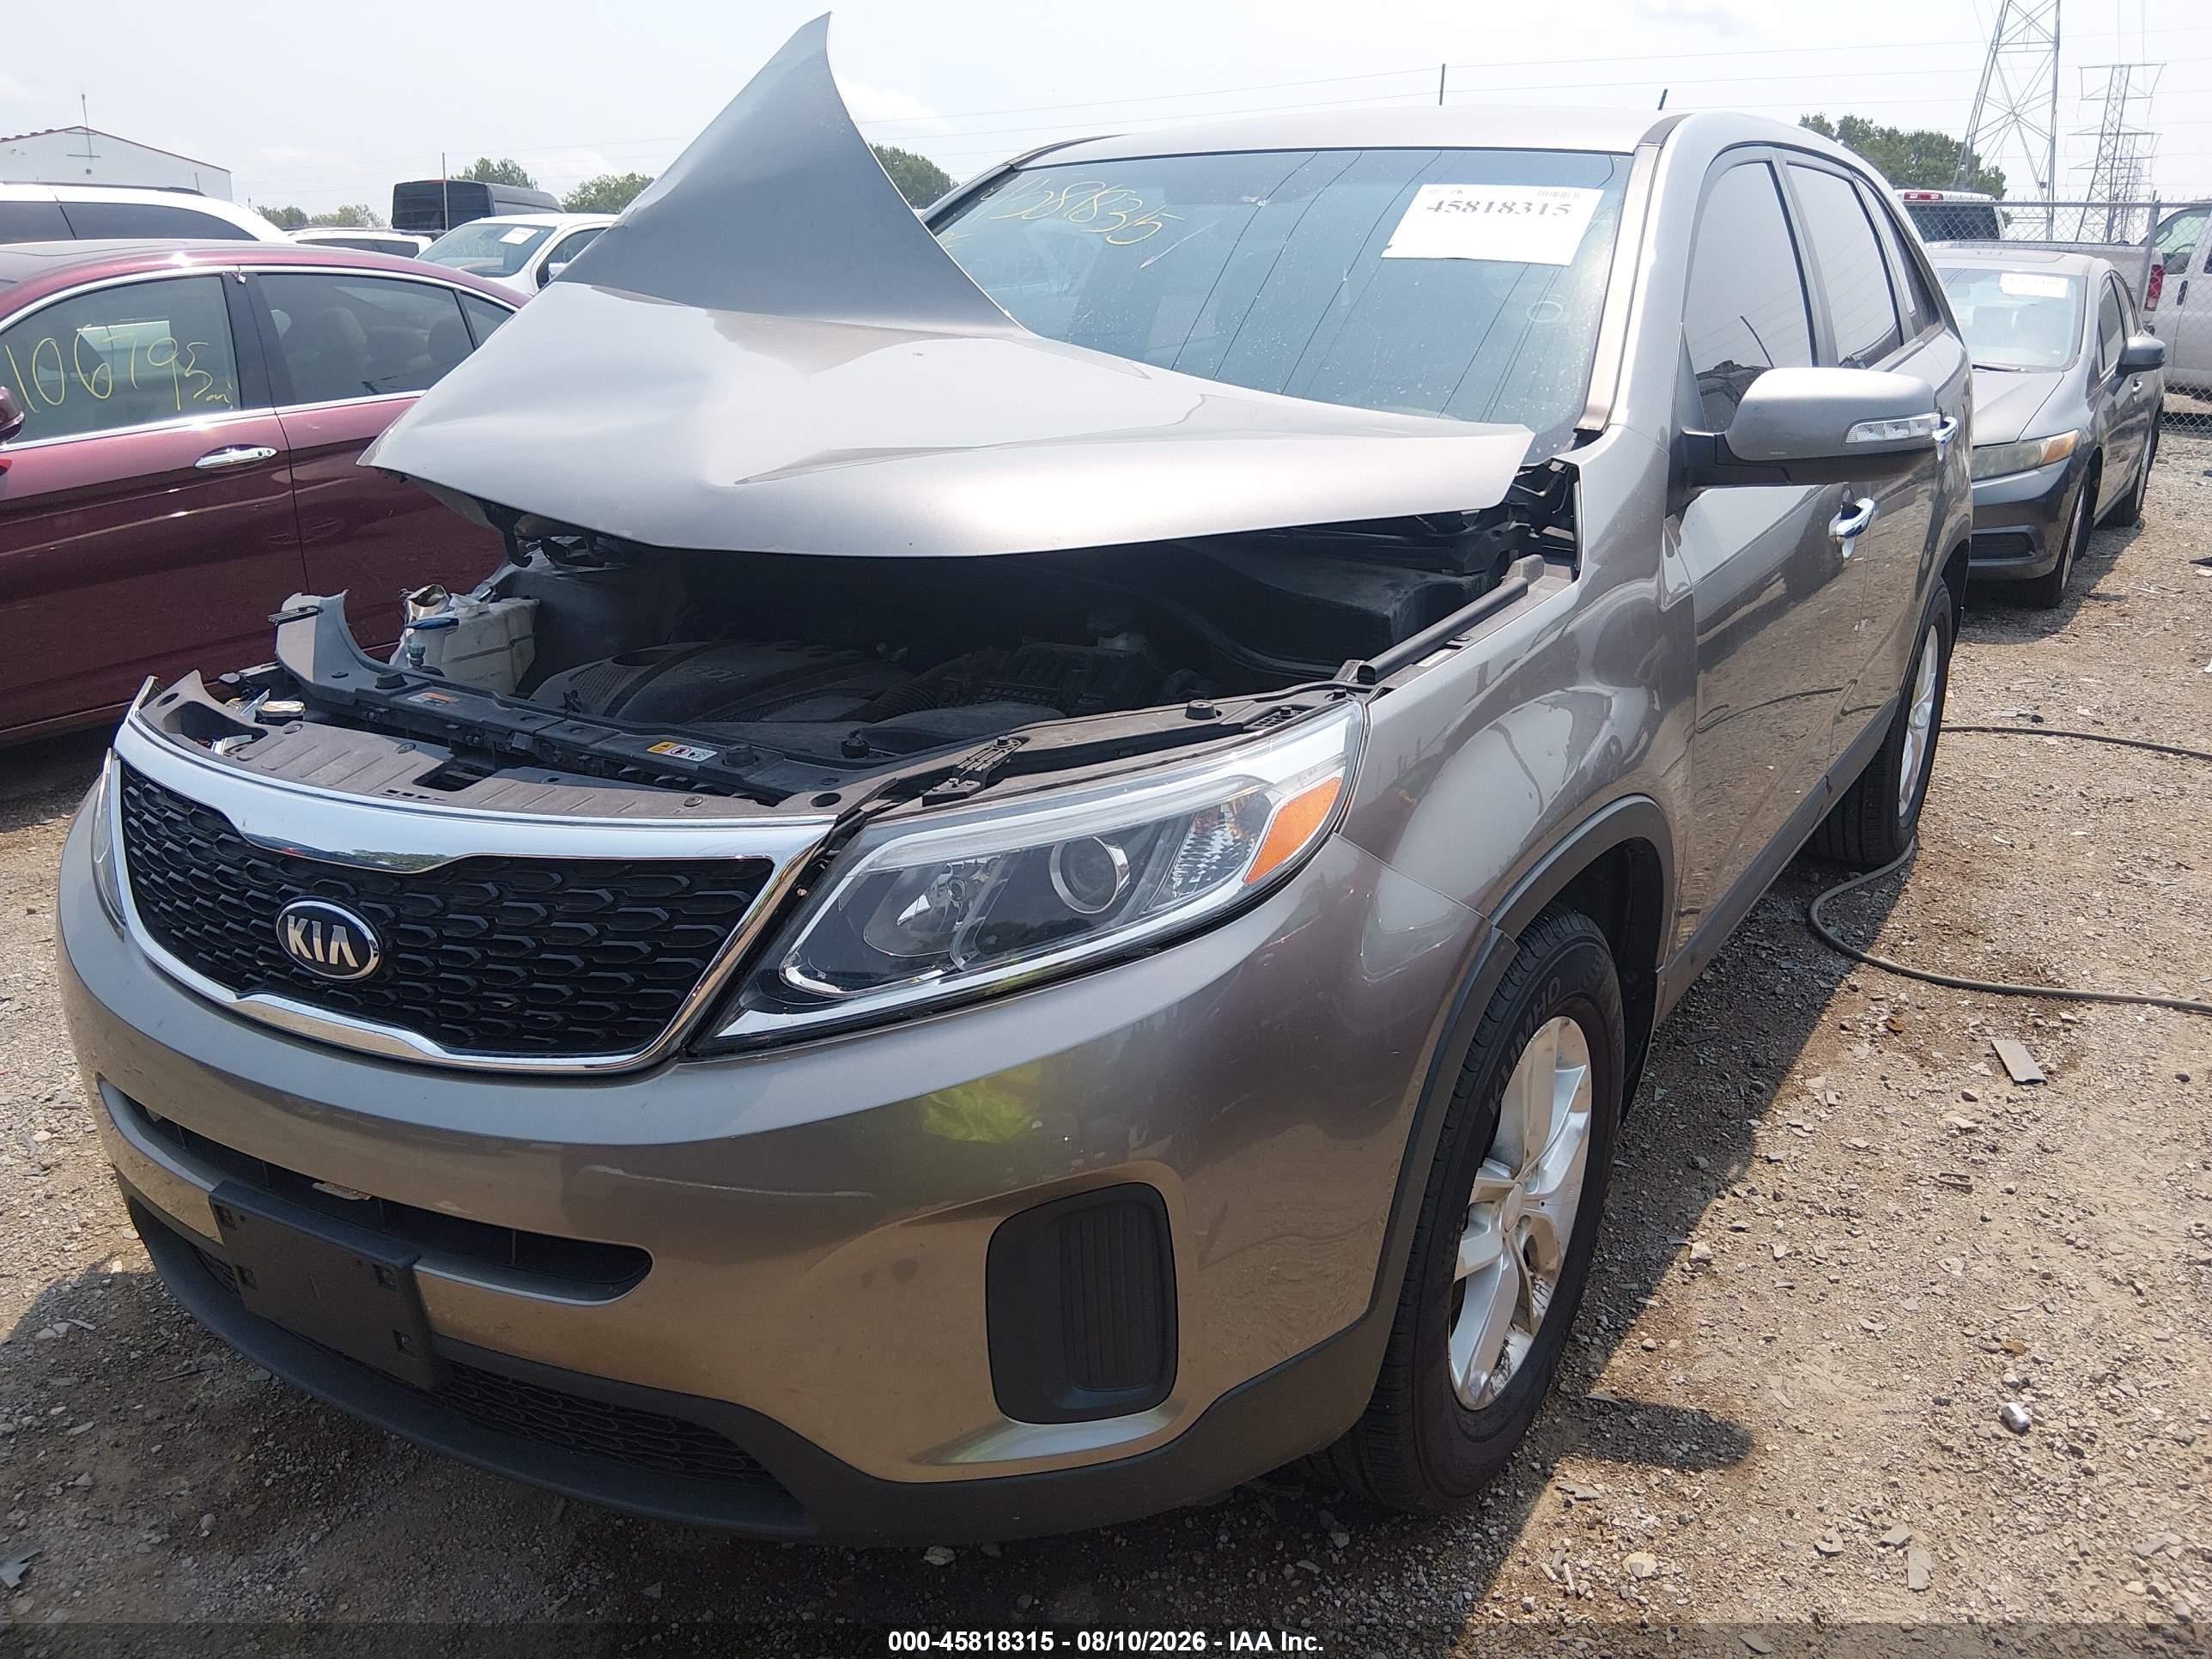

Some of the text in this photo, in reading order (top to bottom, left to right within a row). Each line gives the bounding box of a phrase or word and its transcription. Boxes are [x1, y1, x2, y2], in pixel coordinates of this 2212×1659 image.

[1426, 199, 1572, 216] 45818315
[4, 324, 214, 413] 106795
[287, 915, 360, 969] KIA
